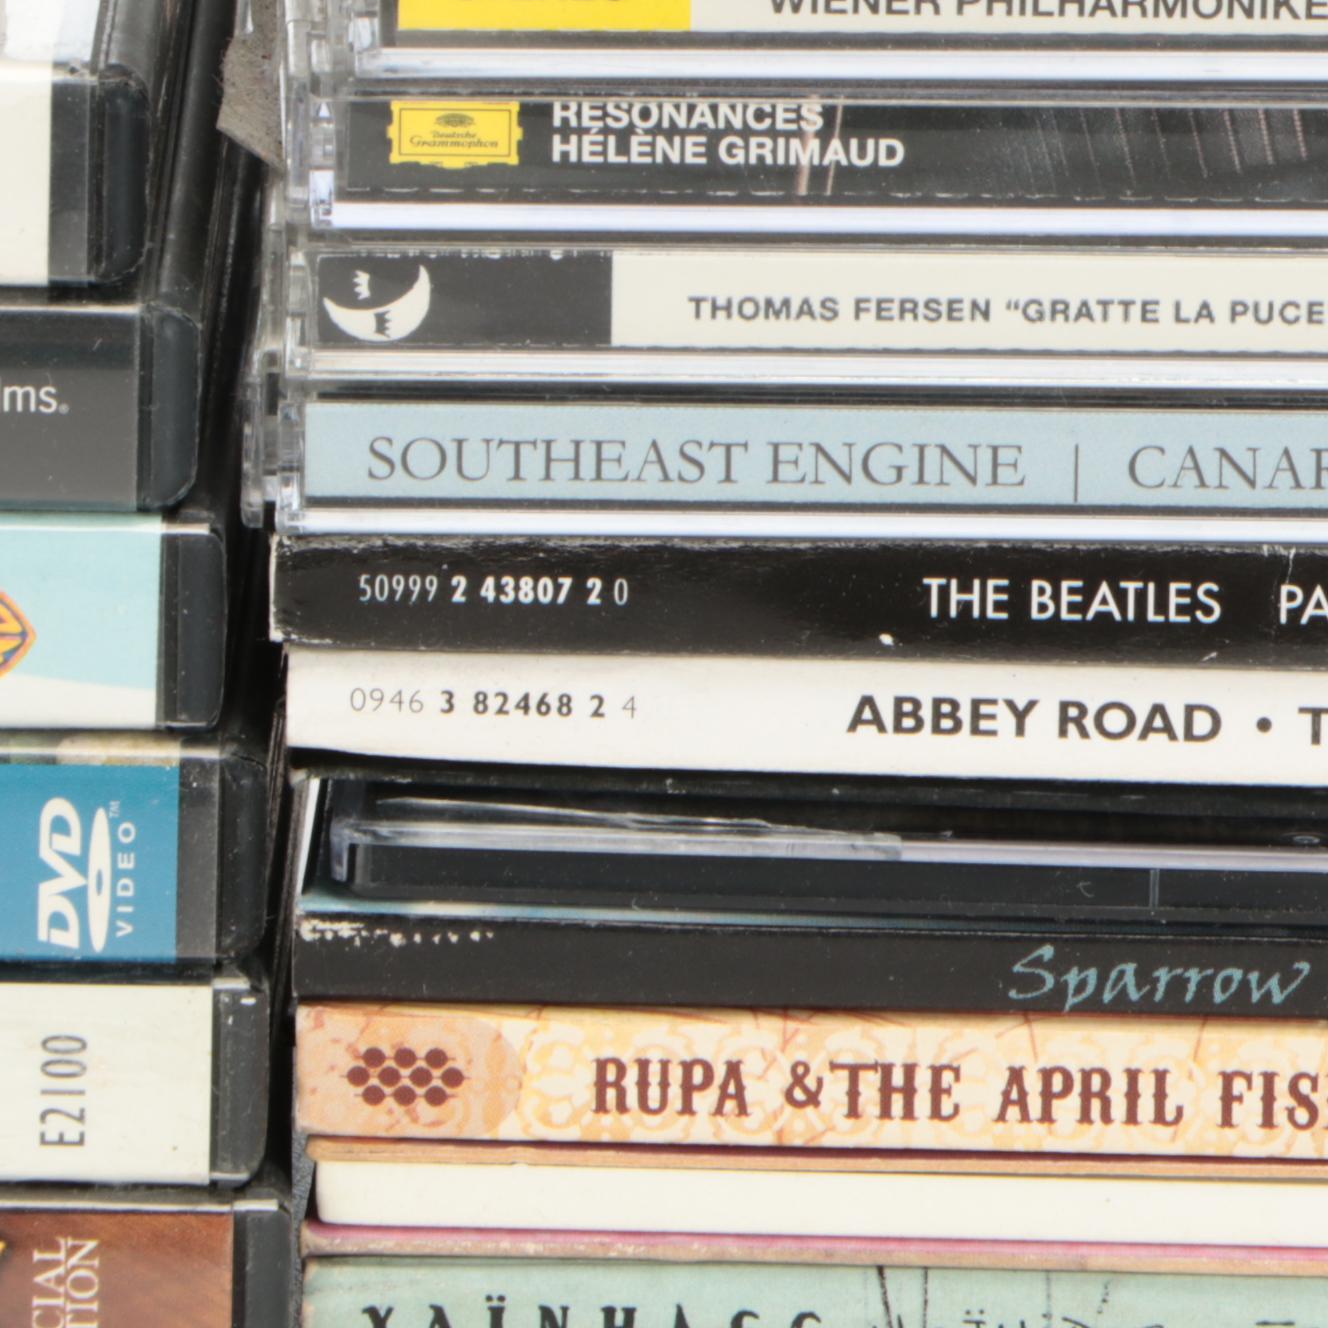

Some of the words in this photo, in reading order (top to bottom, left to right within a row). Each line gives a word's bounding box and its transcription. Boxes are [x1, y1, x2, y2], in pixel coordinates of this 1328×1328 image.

[551, 102, 823, 132] RESONANCES
[408, 135, 499, 149] Grammophon
[551, 128, 708, 164] HÉLÈNE
[717, 134, 905, 168] GRIMAUD
[687, 296, 840, 323] THOMAS
[854, 297, 991, 323] FERSEN
[1173, 300, 1216, 324] LA
[367, 436, 749, 484] SOUTHEAST
[766, 441, 1026, 487] ENGINE
[359, 573, 438, 602] 50999
[450, 575, 467, 603] 2
[479, 575, 573, 604] 43807
[586, 577, 603, 605] 2
[613, 578, 629, 606] 0
[922, 577, 1010, 620] THE
[1030, 579, 1222, 624] BEATLES
[349, 687, 425, 714] 0946
[440, 689, 455, 715] 3
[472, 690, 573, 718] 82468
[590, 694, 605, 719] 2
[621, 695, 637, 719] 4
[846, 694, 1039, 738] ABBEY
[1058, 700, 1222, 743] ROAD
[38, 796, 82, 950] DVD
[110, 821, 136, 938] VIDEO
[1008, 944, 1309, 1013] Sparrow
[39, 1034, 88, 1148] E2100
[592, 1057, 750, 1118] RUPA
[993, 1065, 1184, 1128] APRIL
[32, 1236, 66, 1328] CIAL
